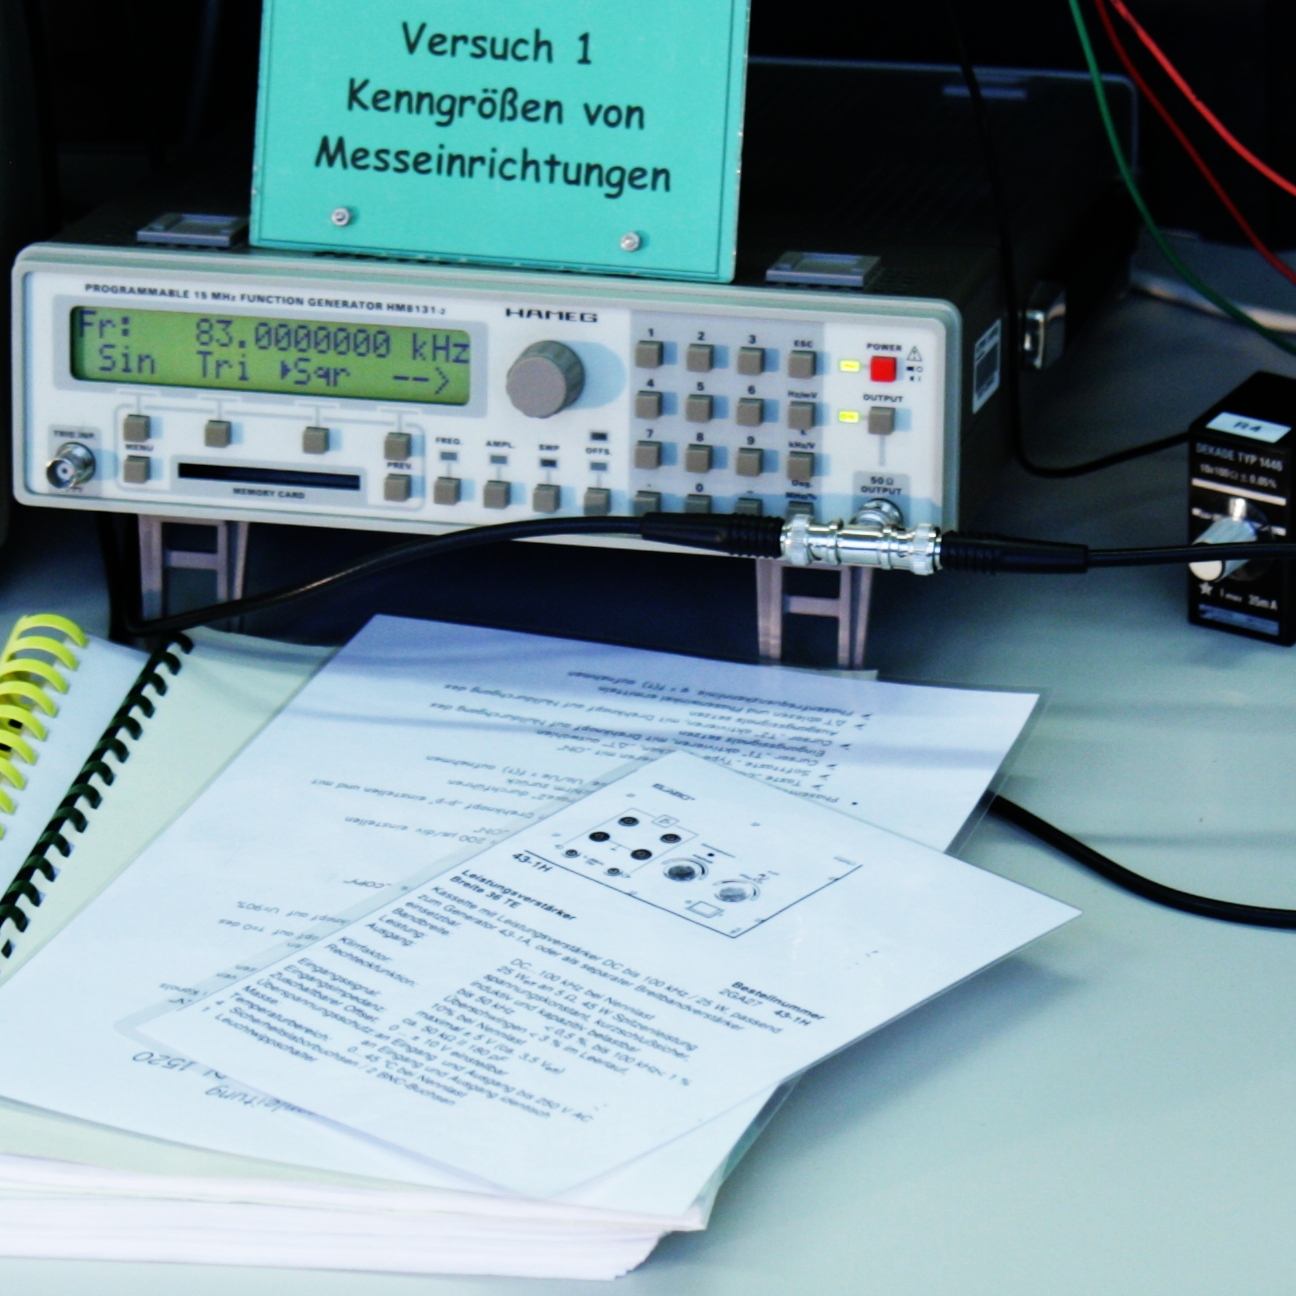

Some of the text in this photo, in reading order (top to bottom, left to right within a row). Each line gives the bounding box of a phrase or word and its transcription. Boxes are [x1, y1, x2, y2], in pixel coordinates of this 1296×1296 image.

[401, 20, 593, 66] Versuch 1
[347, 76, 646, 130] Kenngrößen von
[313, 134, 672, 200] Messeinrichtungen
[84, 283, 190, 300] PROGRAMMABLE
[194, 290, 208, 300] 15
[211, 291, 236, 302] MHz
[240, 293, 305, 307] FUNCTION
[307, 297, 384, 311] GENERATOR
[505, 307, 599, 324] HAMEG
[78, 308, 471, 365] Fr: 83.0000000 kHz
[647, 327, 655, 338] 1
[697, 330, 706, 342] 2
[748, 334, 757, 345] 3
[793, 339, 814, 349] ESC
[866, 342, 903, 352] POWER
[97, 344, 157, 376] Sin
[195, 349, 251, 382] Tri
[646, 378, 655, 389] 4
[696, 381, 705, 392] 5
[747, 384, 756, 395] 6
[862, 393, 904, 403] OUTPUT
[646, 429, 654, 439] 7
[696, 432, 705, 442] 8
[746, 435, 755, 446] 9
[124, 442, 155, 453] MENU
[231, 486, 306, 500] MEMORY CARD
[695, 483, 704, 494] 0
[860, 485, 903, 496] OUTPUT
[460, 868, 577, 922] Leistungsverstärker
[730, 980, 826, 1022] Bestellnummer
[132, 1049, 195, 1074] 1520
